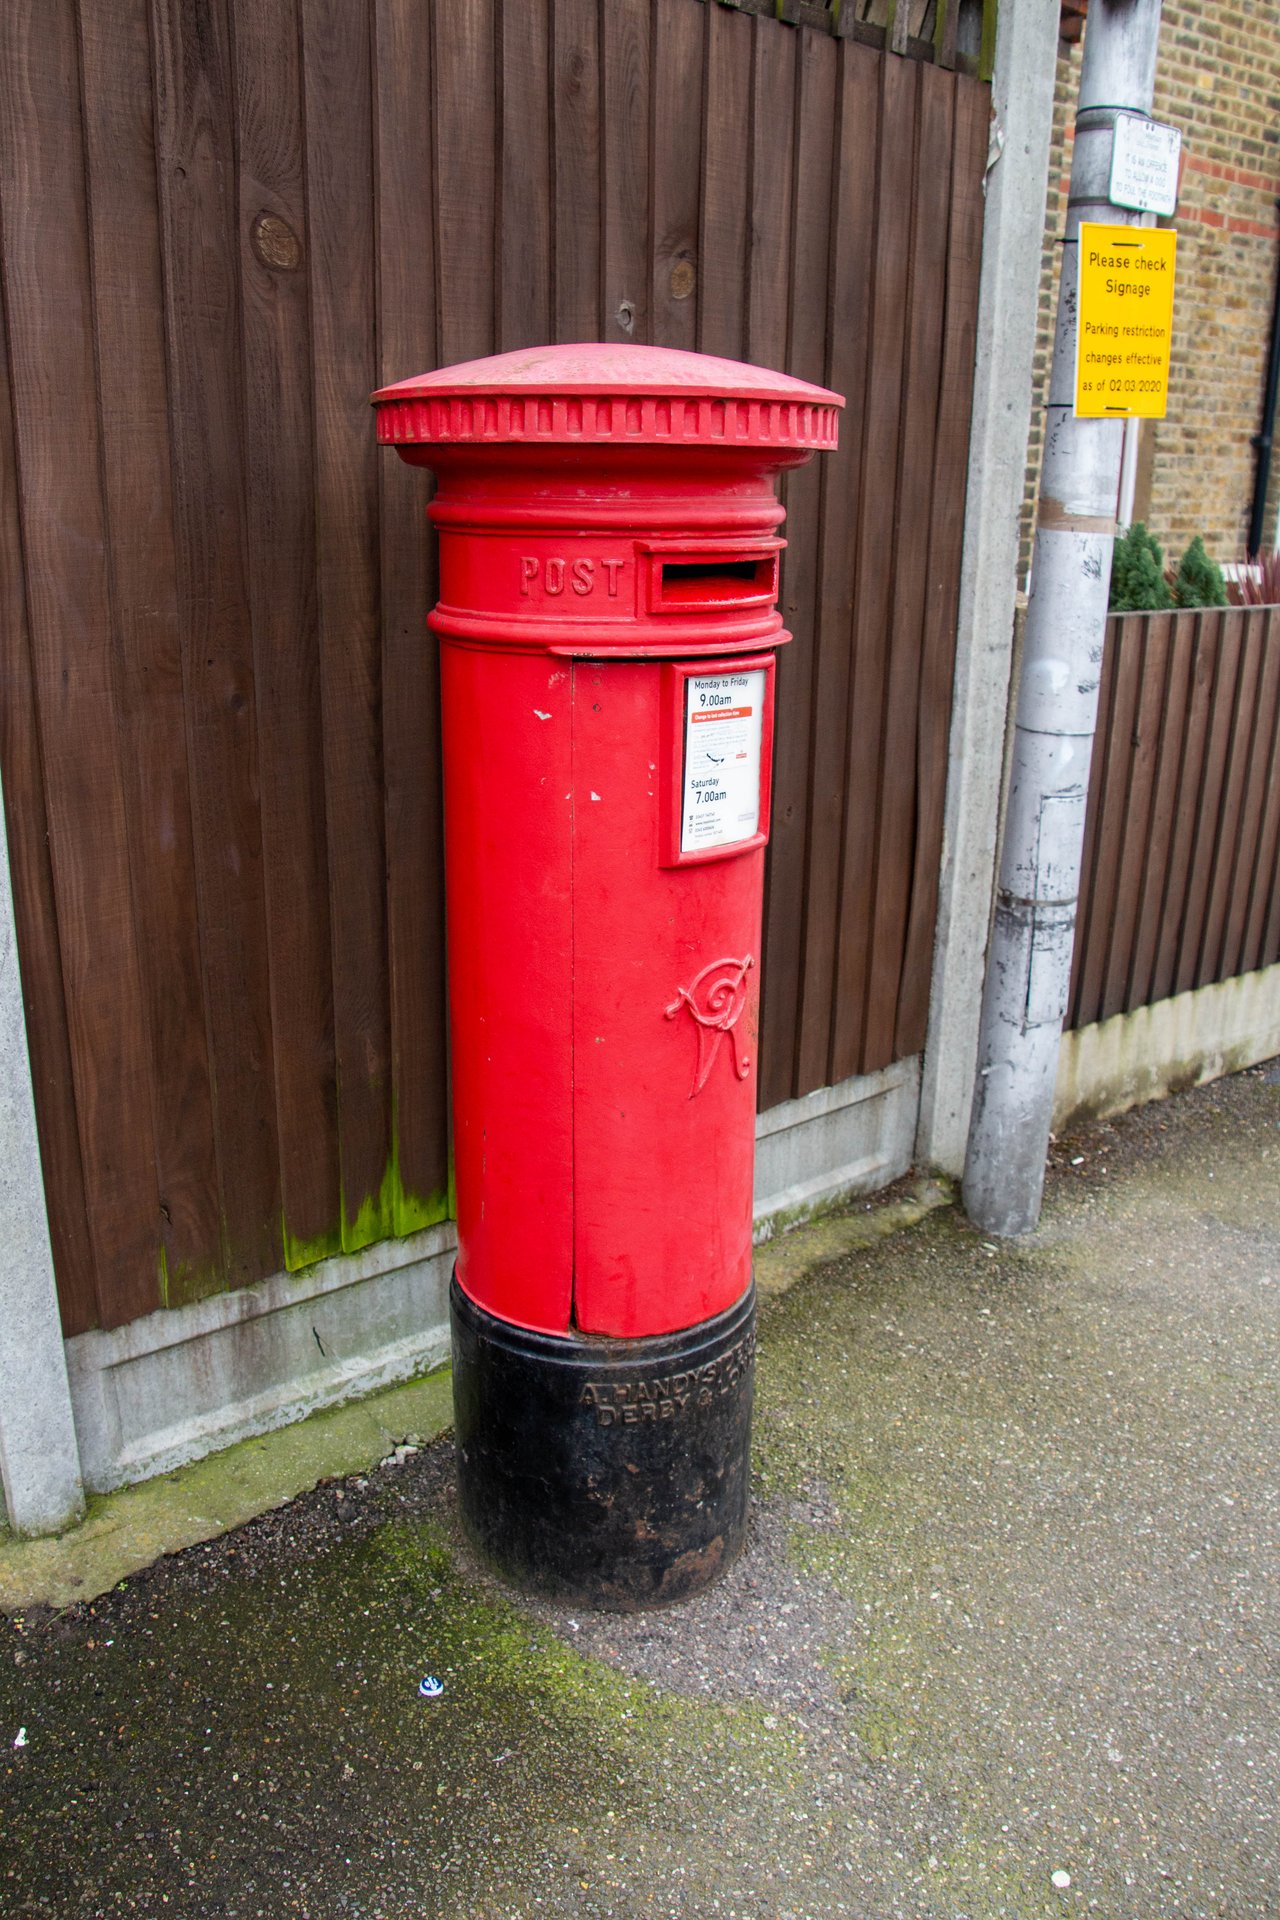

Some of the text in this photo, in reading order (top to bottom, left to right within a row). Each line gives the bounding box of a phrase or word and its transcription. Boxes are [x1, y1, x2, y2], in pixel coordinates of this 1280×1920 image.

[1089, 252, 1167, 271] Please check
[1106, 279, 1151, 297] Signage
[1085, 322, 1166, 338] Parking restriction
[1086, 351, 1162, 366] changes effective
[1083, 381, 1093, 392] as
[1097, 380, 1106, 392] of
[520, 556, 624, 596] POST
[695, 680, 720, 690] Monday
[730, 677, 749, 687] Friday
[700, 694, 732, 707] 9.00am
[691, 777, 719, 789] Saturday
[696, 791, 727, 804] 7.00am
[597, 1393, 691, 1426] DERBY
